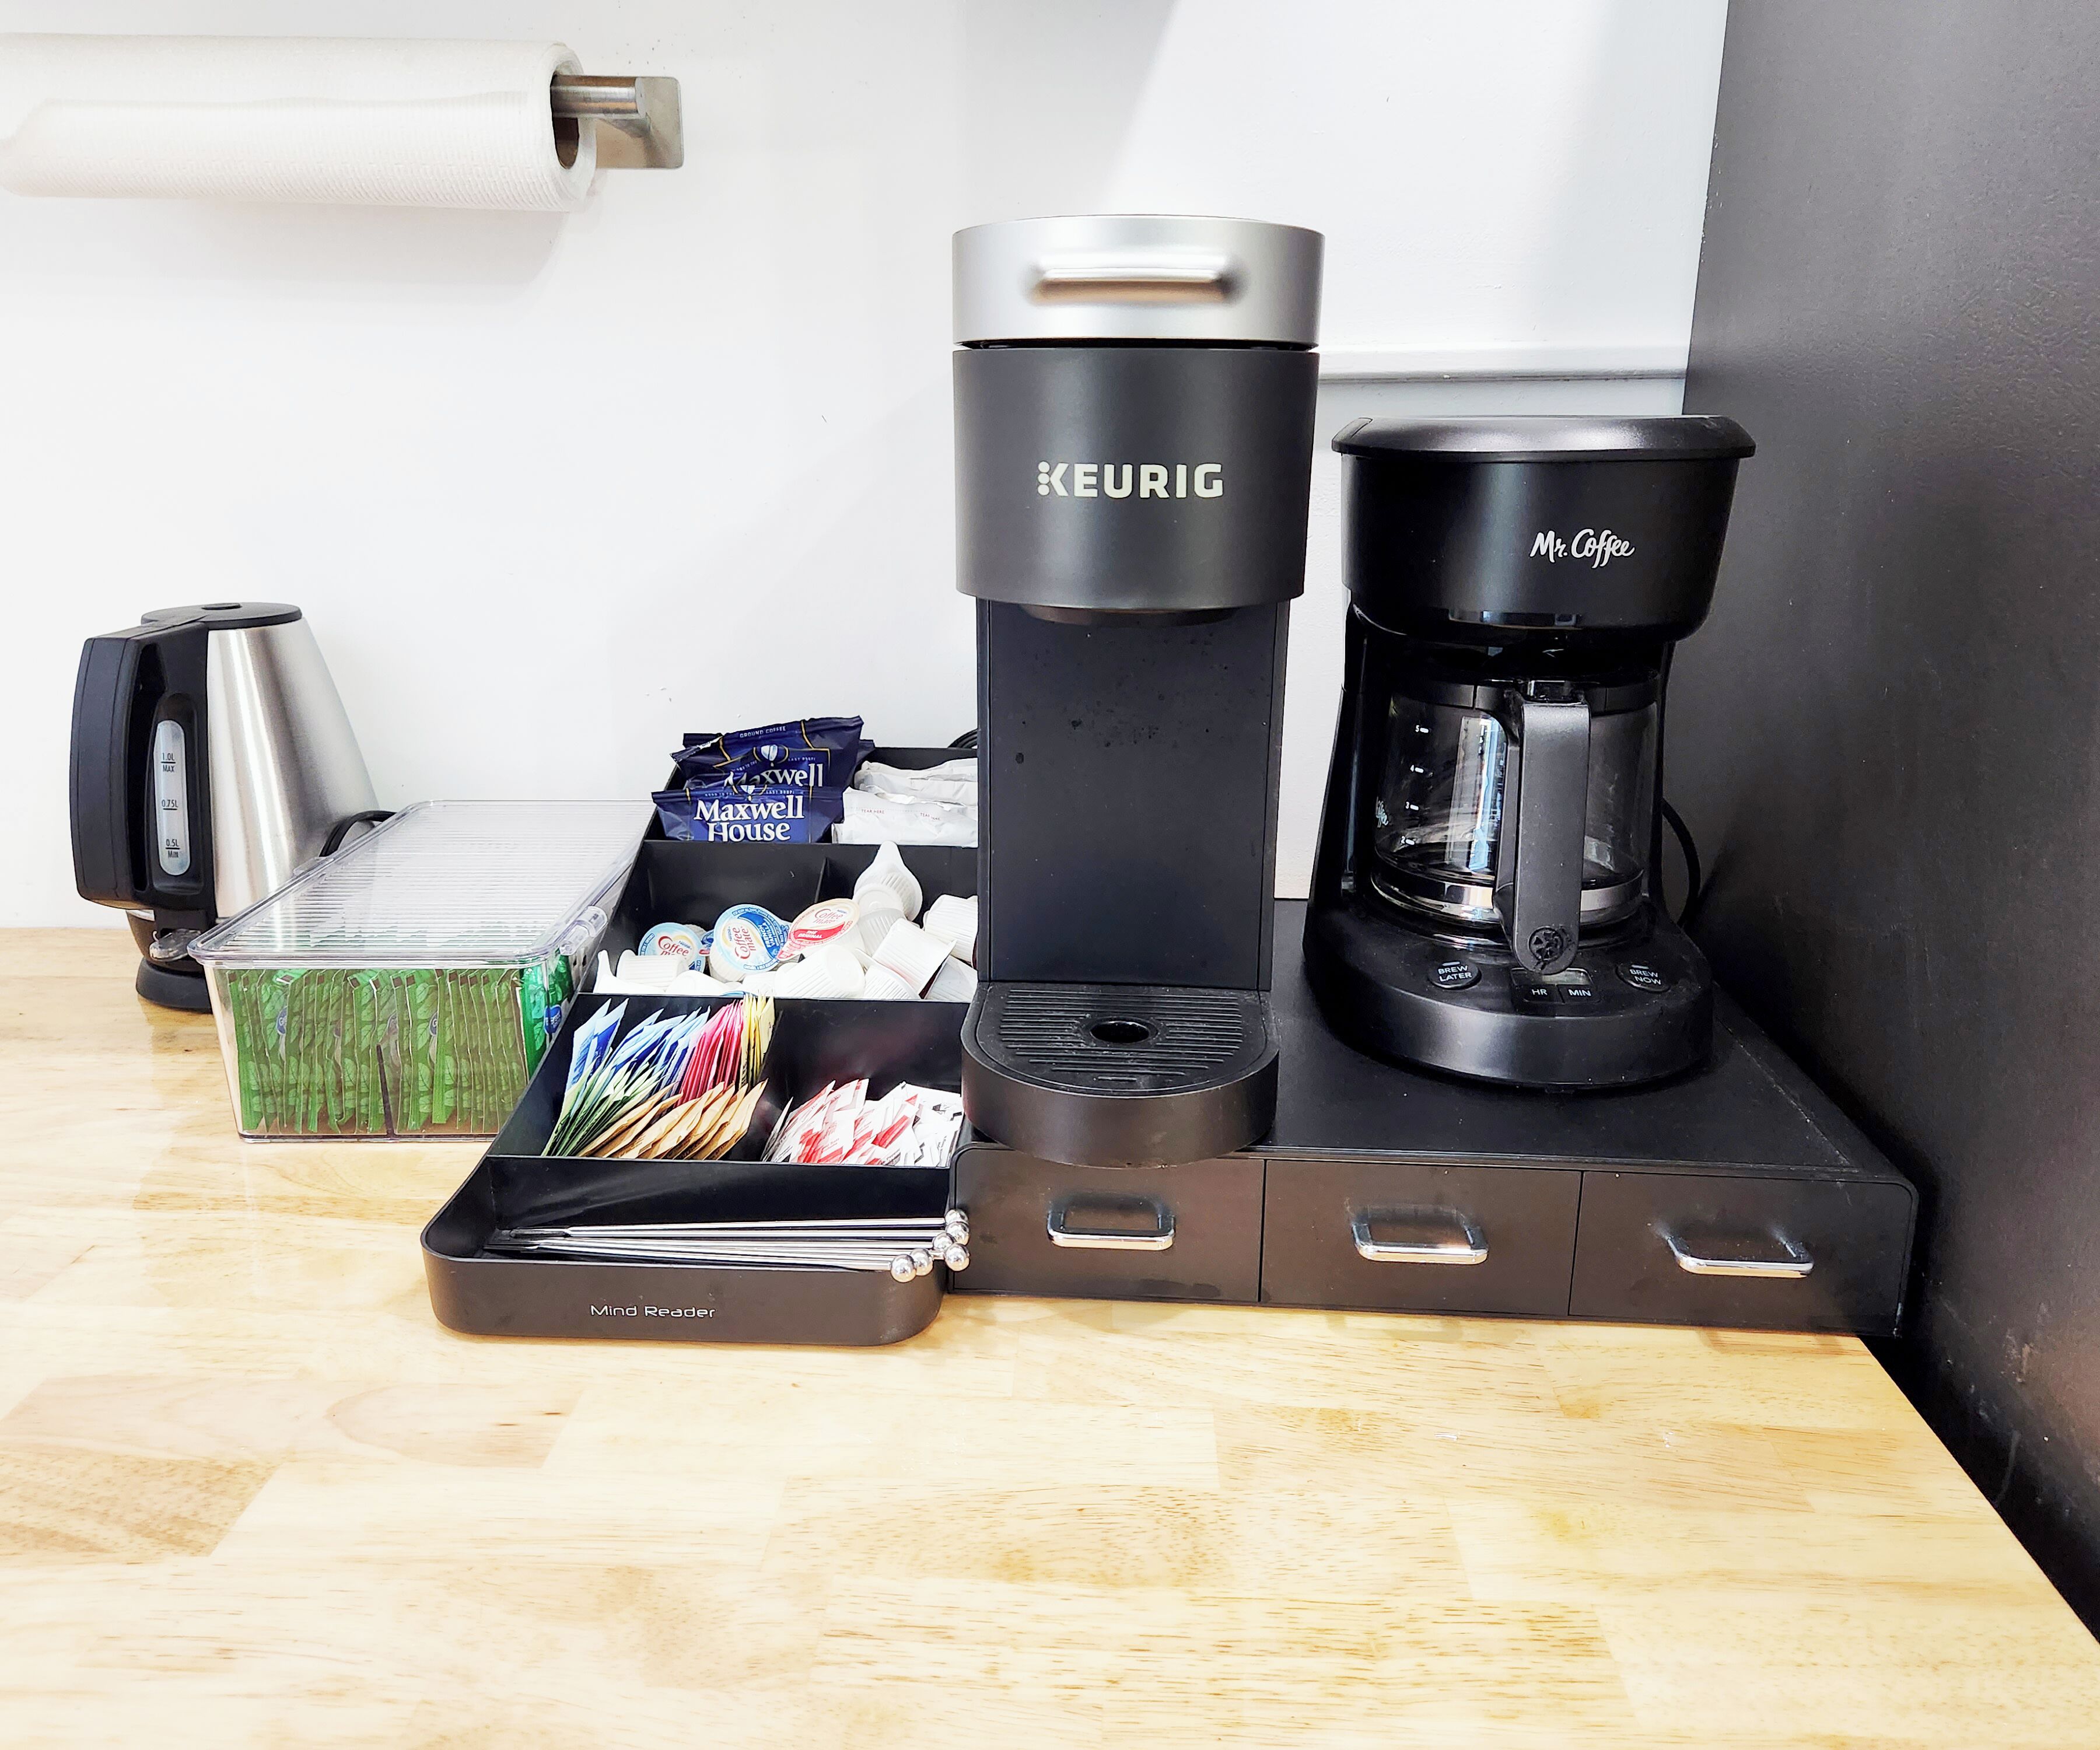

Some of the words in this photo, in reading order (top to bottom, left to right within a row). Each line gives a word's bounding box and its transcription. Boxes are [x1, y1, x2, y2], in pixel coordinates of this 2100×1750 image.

[1037, 461, 1223, 499] KEURIG
[1530, 530, 1567, 563] Mr.
[1571, 528, 1635, 569] Coffee
[740, 730, 764, 738] GROUND
[162, 752, 175, 761] 1.0L
[723, 763, 823, 788] Maxwell
[162, 799, 178, 807] 0.75L
[694, 795, 804, 821] Maxwell
[707, 821, 790, 842] House
[166, 839, 179, 847] 0.5L
[1401, 836, 1405, 844] 2
[815, 908, 844, 919] Coffee
[741, 929, 757, 951] mate
[758, 925, 771, 948] FRENCH
[762, 922, 775, 946] VANILLA
[658, 936, 689, 957] Coffee
[733, 928, 751, 959] Coffee
[1438, 964, 1468, 975] BREW
[1629, 969, 1658, 978] BREW
[1439, 971, 1472, 982] LATER
[1634, 975, 1662, 985] NOW
[1568, 989, 1592, 997] MIN
[590, 1304, 638, 1317] Mind
[644, 1306, 716, 1318] Reader
